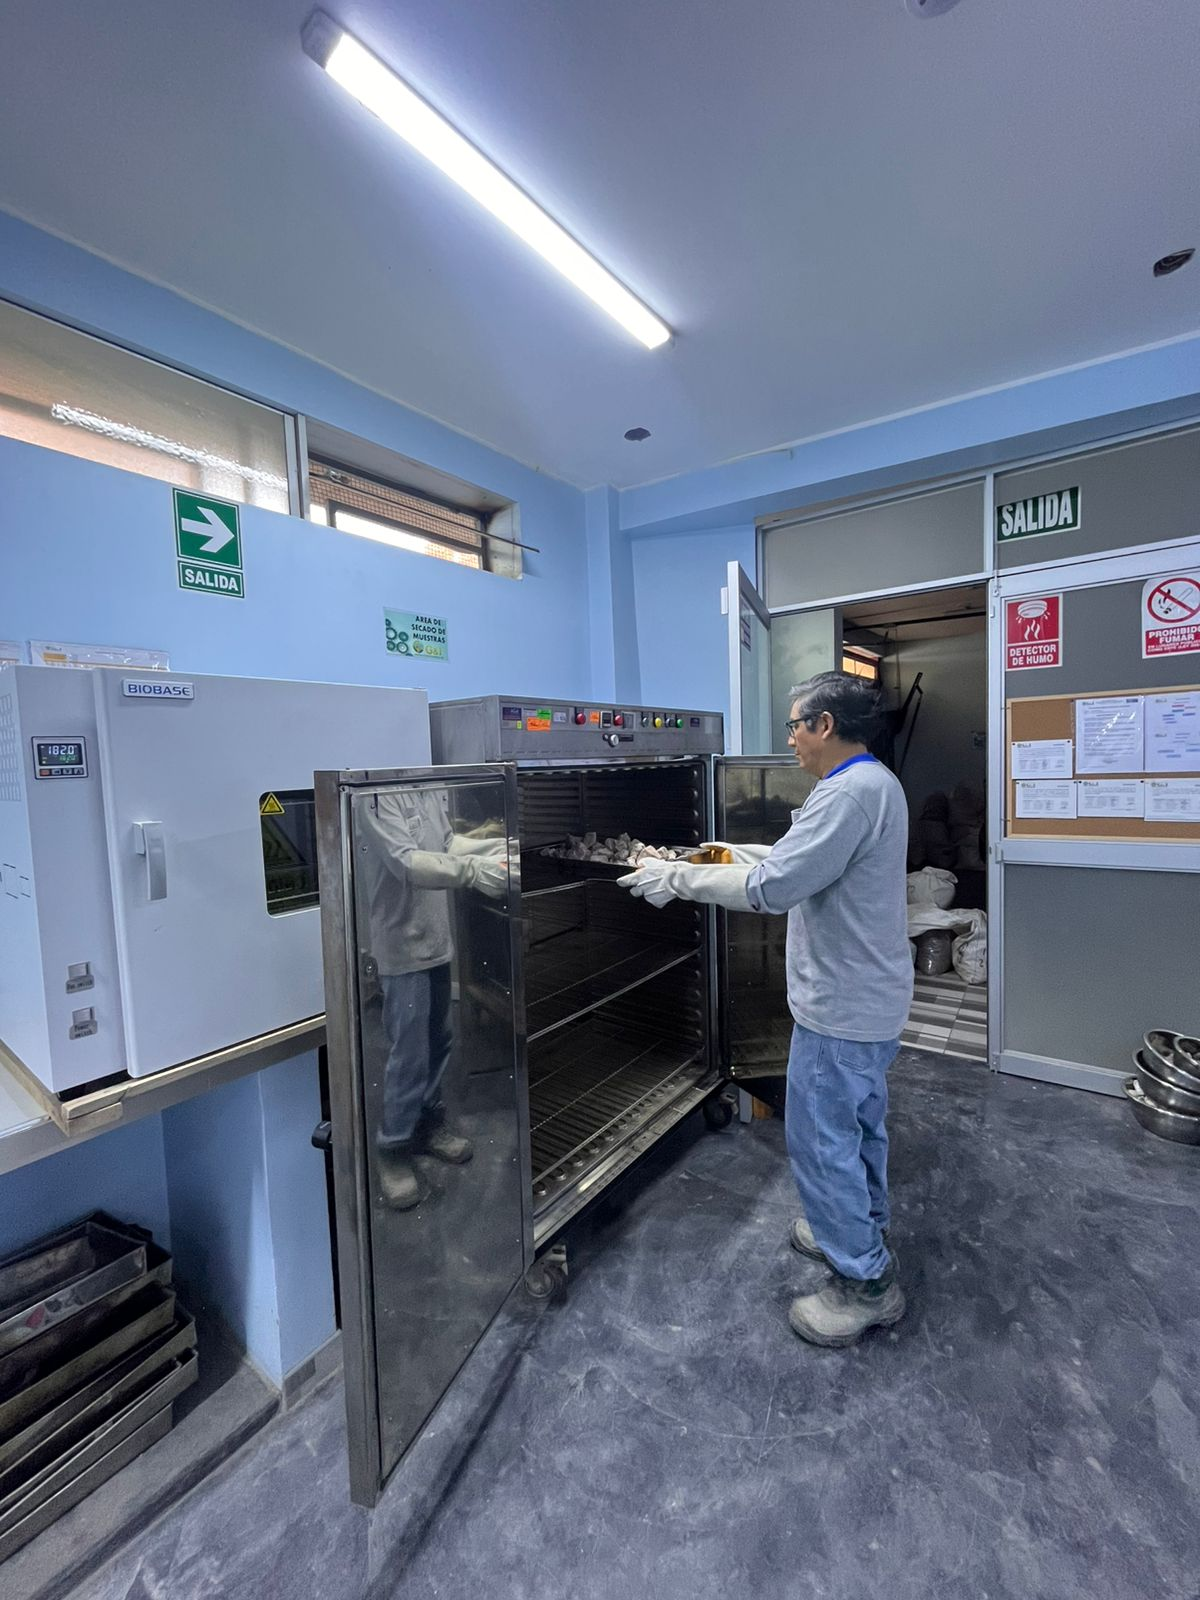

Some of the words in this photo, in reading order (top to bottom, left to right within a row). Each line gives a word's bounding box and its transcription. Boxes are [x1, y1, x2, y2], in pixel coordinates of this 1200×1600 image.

[1001, 490, 1073, 537] SALIDA
[184, 568, 239, 592] SALIDA
[415, 615, 433, 625] AREA
[411, 623, 437, 634] SECADO
[437, 628, 446, 636] DE
[412, 632, 446, 644] MUESTRAS
[1160, 633, 1195, 644] FUMAR
[1010, 644, 1057, 657] DETECTOR
[1012, 657, 1024, 666] DE
[1026, 653, 1054, 665] HUMO
[128, 684, 190, 696] BIOBASE
